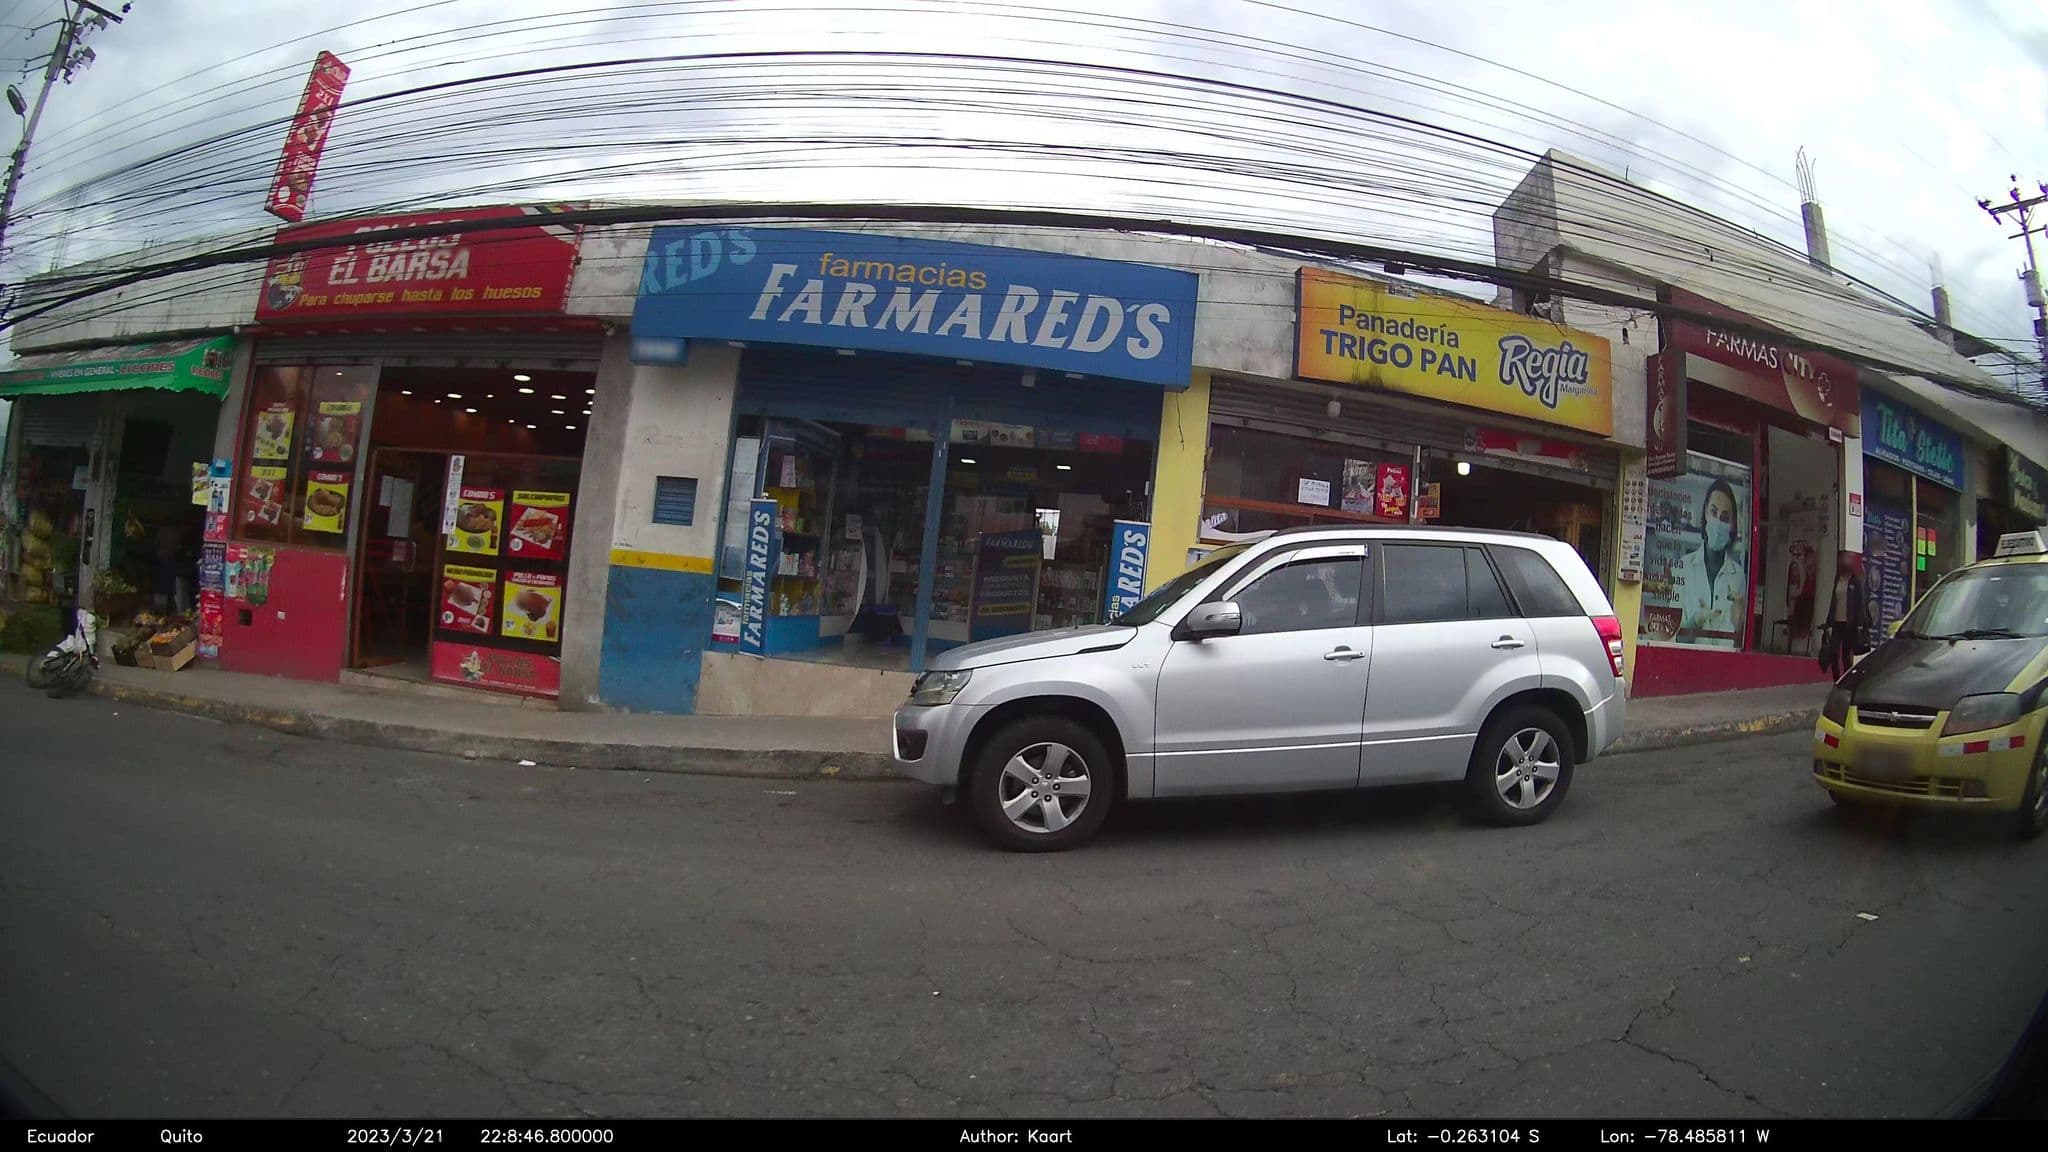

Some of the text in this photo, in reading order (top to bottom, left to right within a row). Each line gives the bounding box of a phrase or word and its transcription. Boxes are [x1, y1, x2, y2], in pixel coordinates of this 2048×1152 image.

[328, 248, 471, 285] EL BARSA
[819, 252, 987, 290] farmacias
[299, 284, 544, 308] Para chuparse hasta los huesos
[1339, 303, 1460, 349] Panadería
[119, 361, 176, 375] LICORES
[1320, 329, 1477, 382] TRIGO PAN
[1706, 329, 1778, 369] FARMAS
[1498, 335, 1589, 409] Regia
[743, 509, 772, 648] FARMARED'S
